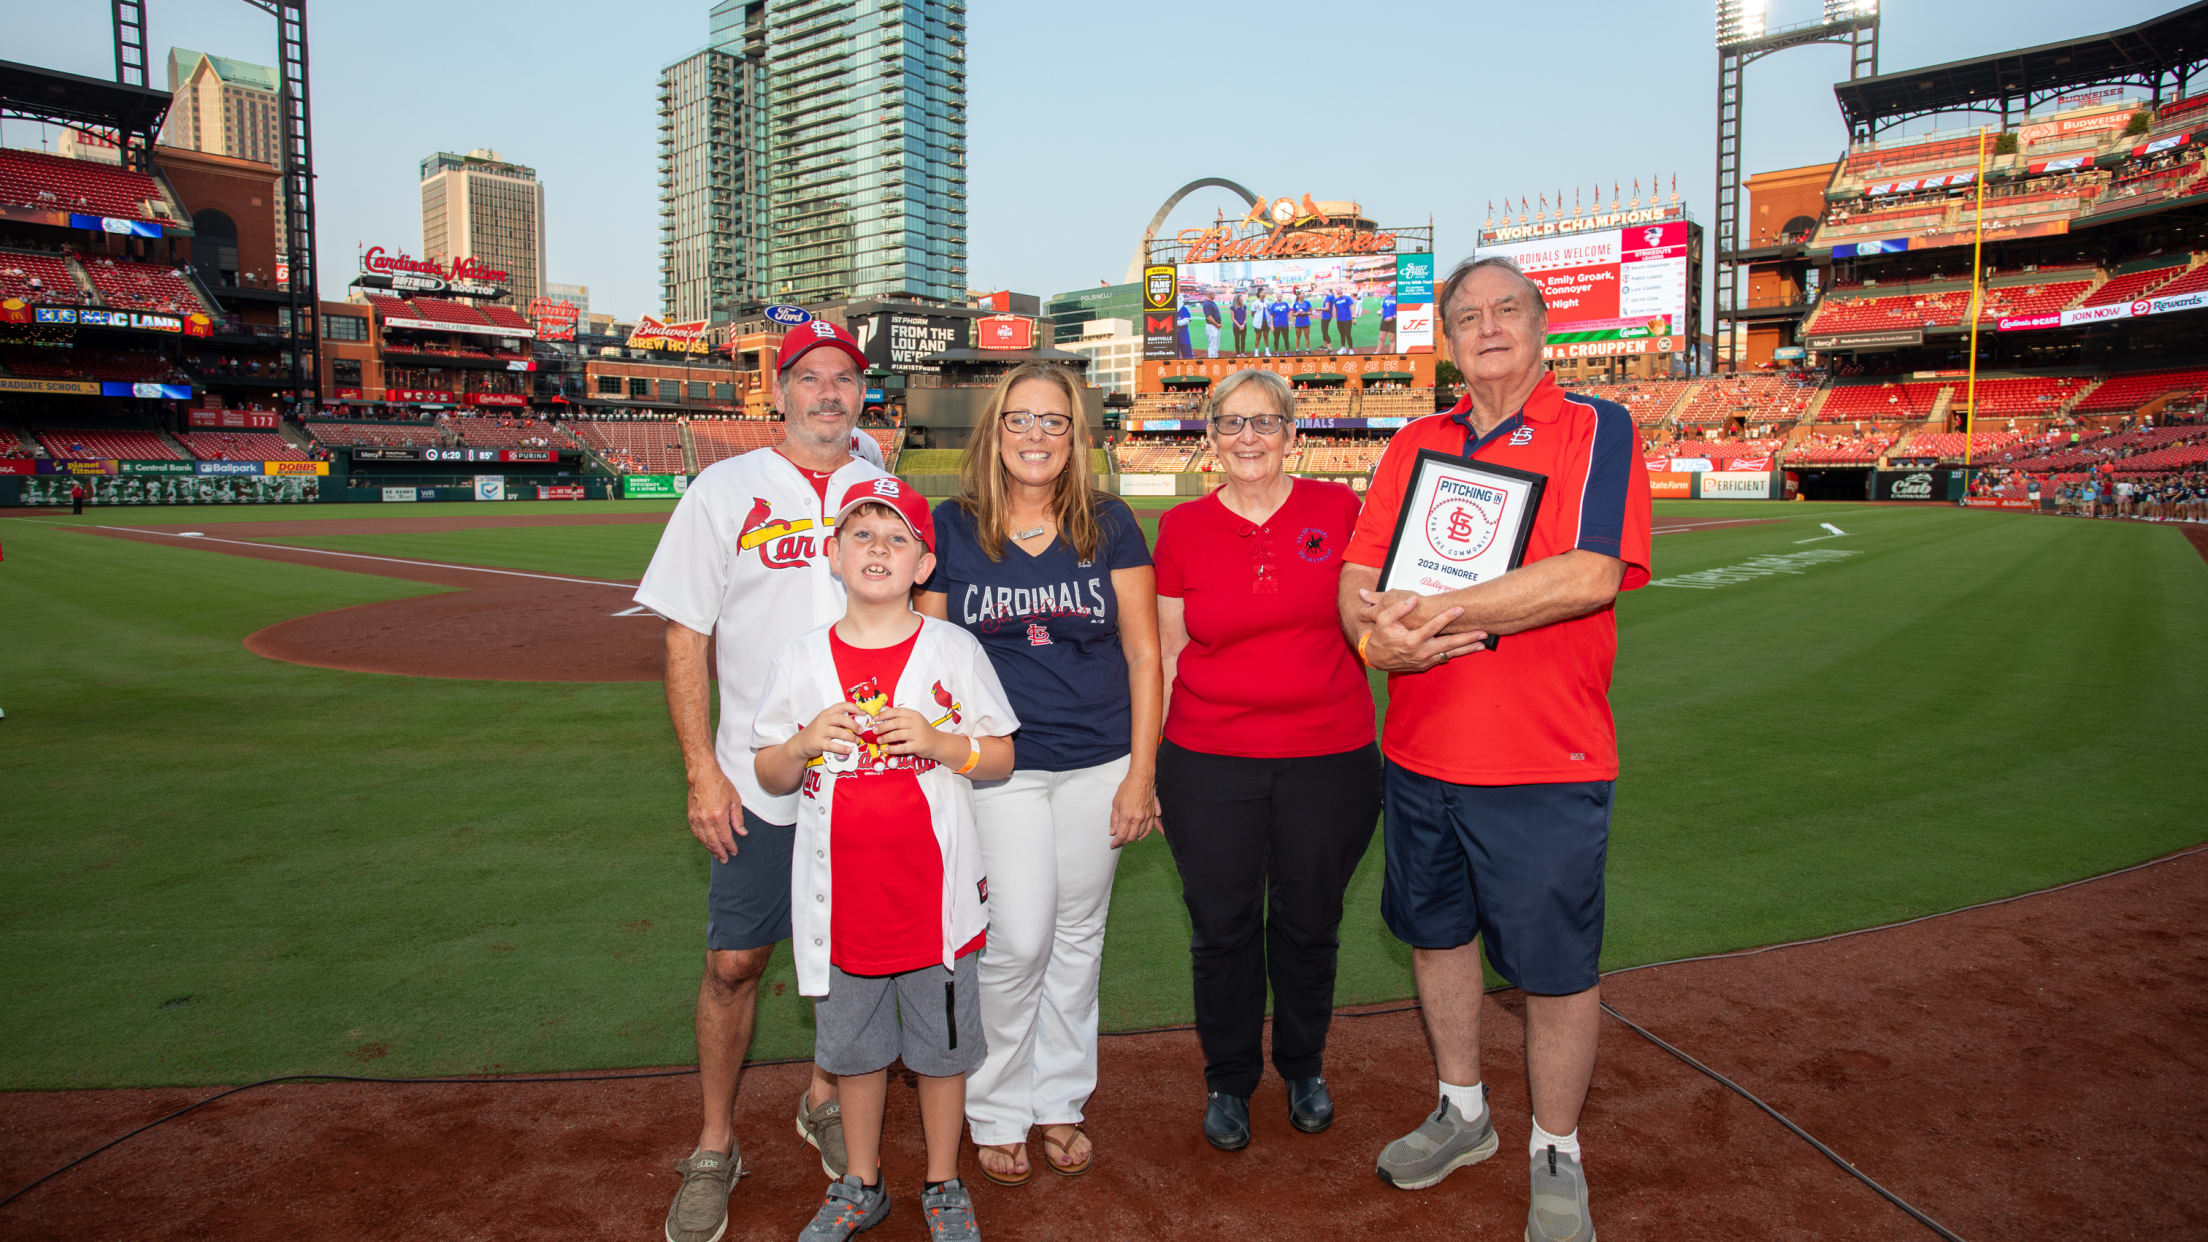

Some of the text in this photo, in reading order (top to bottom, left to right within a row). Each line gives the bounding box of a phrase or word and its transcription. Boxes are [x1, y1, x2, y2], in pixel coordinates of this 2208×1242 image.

[2057, 87, 2124, 104] BUDWEISER
[2063, 113, 2131, 130] BUDWEISER
[1496, 208, 1665, 241] WORLD CHAMPIONS
[1178, 224, 1396, 264] Budweiser
[1509, 243, 1612, 264] ARDINALS WELCOME
[1634, 248, 1672, 258] STRIKEOUTS
[365, 246, 507, 282] Cardinals Nation
[1548, 270, 1614, 286] Emily Groark,
[451, 284, 496, 295] ROOFTOP
[1080, 292, 1112, 302] POLSINELLI
[1545, 283, 1592, 295] Connoyer
[528, 296, 581, 324] Bally
[1552, 298, 1579, 310] Night
[2072, 295, 2203, 322] JOIN NOW Rewards
[35, 308, 182, 332] BIG MAC LAND
[774, 306, 803, 322] Ford
[2039, 316, 2059, 325] CARE
[634, 322, 708, 338] Budweiser
[891, 324, 955, 341] FROM THE
[629, 337, 709, 354] BREW HOUSE
[891, 337, 946, 352] LOU AND
[1557, 348, 1565, 357] &
[1569, 340, 1643, 357] CROUPPEN
[1186, 365, 1194, 376] 2
[1302, 362, 1315, 373] 23
[1322, 362, 1336, 373] 24
[1342, 361, 1357, 373] 42
[1364, 361, 1380, 372] 45
[1384, 361, 1399, 371] 85
[0, 380, 82, 392] RADUATE SCHOOL
[252, 416, 273, 426] 177
[1296, 418, 1334, 428] DINALS
[442, 451, 460, 460] 6:20
[68, 461, 100, 470] planet
[72, 467, 105, 475] fitness
[214, 464, 256, 474] Ballpark
[278, 463, 317, 471] DOBBS
[1440, 480, 1493, 502] PITCHING
[1704, 478, 1766, 492] PERFICIENT
[1494, 494, 1502, 503] IN
[1434, 536, 1444, 550] THE
[1448, 530, 1490, 556] COMMUNITY
[1417, 558, 1479, 581] 2023 HONOREE
[1420, 576, 1444, 592] Bally
[964, 578, 1106, 625] CARDINALS
[697, 1160, 718, 1168] dude
